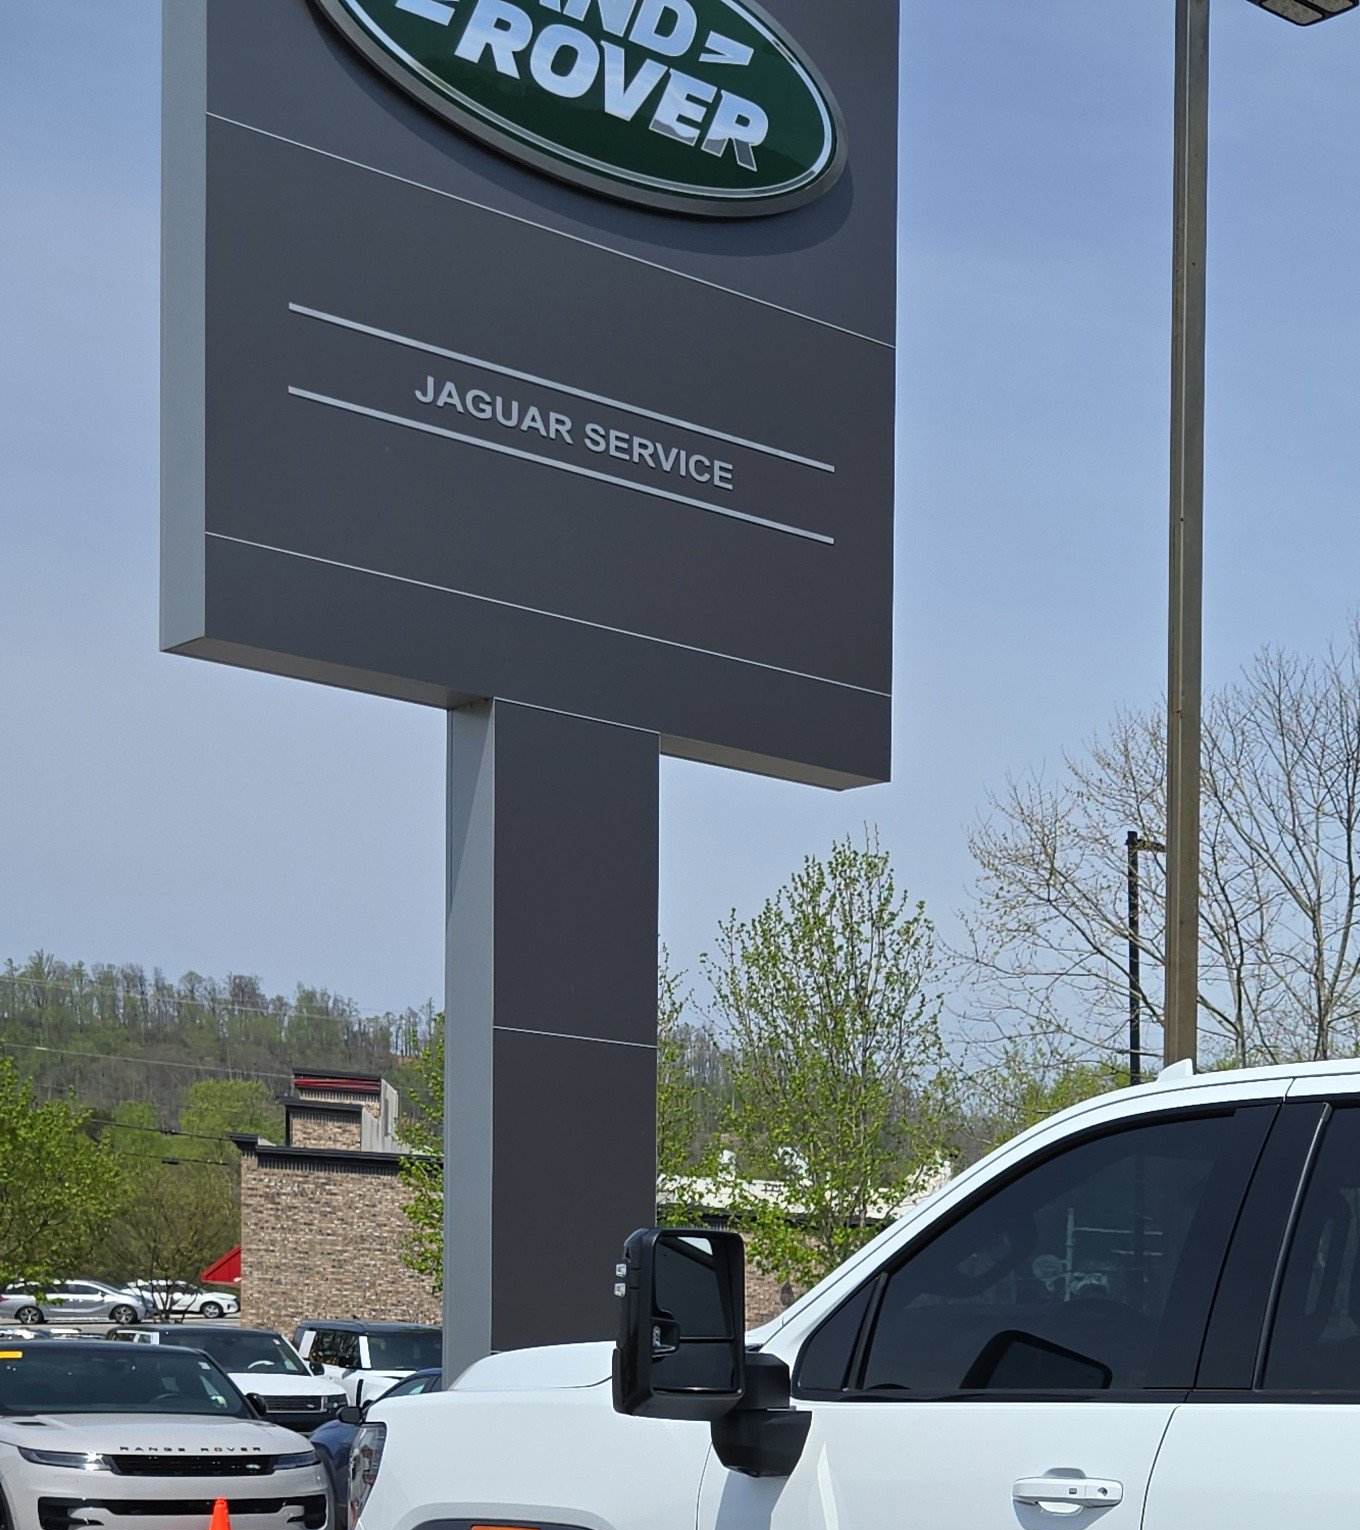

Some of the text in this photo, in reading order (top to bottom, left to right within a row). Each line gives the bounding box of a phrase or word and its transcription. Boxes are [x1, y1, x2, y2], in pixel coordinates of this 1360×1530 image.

[454, 0, 769, 171] ROVER
[414, 375, 734, 491] JAGUAR SERVICE
